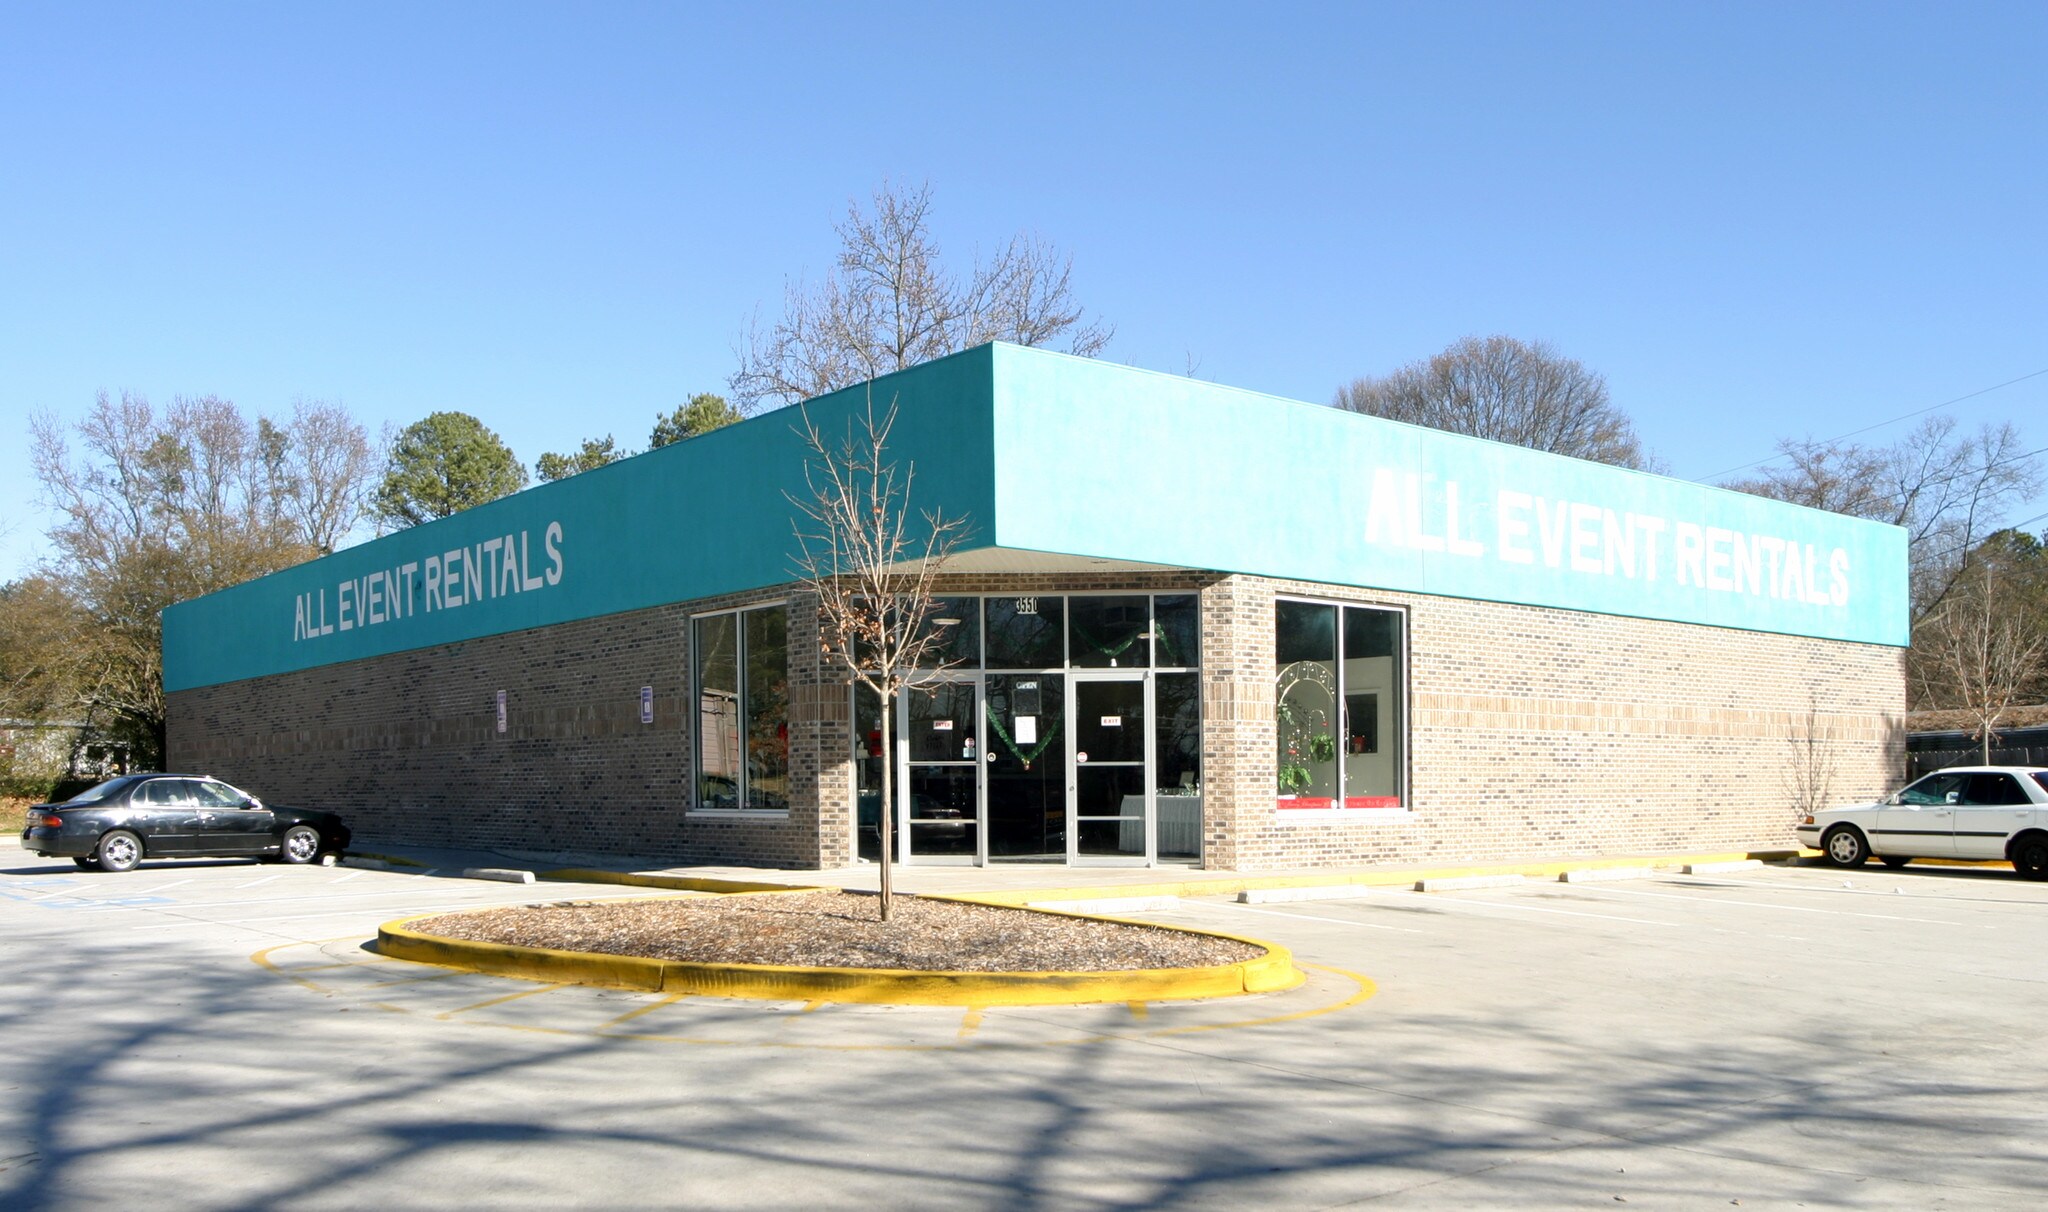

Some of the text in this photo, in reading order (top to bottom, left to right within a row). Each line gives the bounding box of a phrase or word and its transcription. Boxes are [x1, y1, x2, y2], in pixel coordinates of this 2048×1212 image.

[294, 521, 563, 641] ALL EVENT RENTALS
[1364, 468, 1850, 606] ALL EVENT RENTALS
[1016, 597, 1039, 612] 3550
